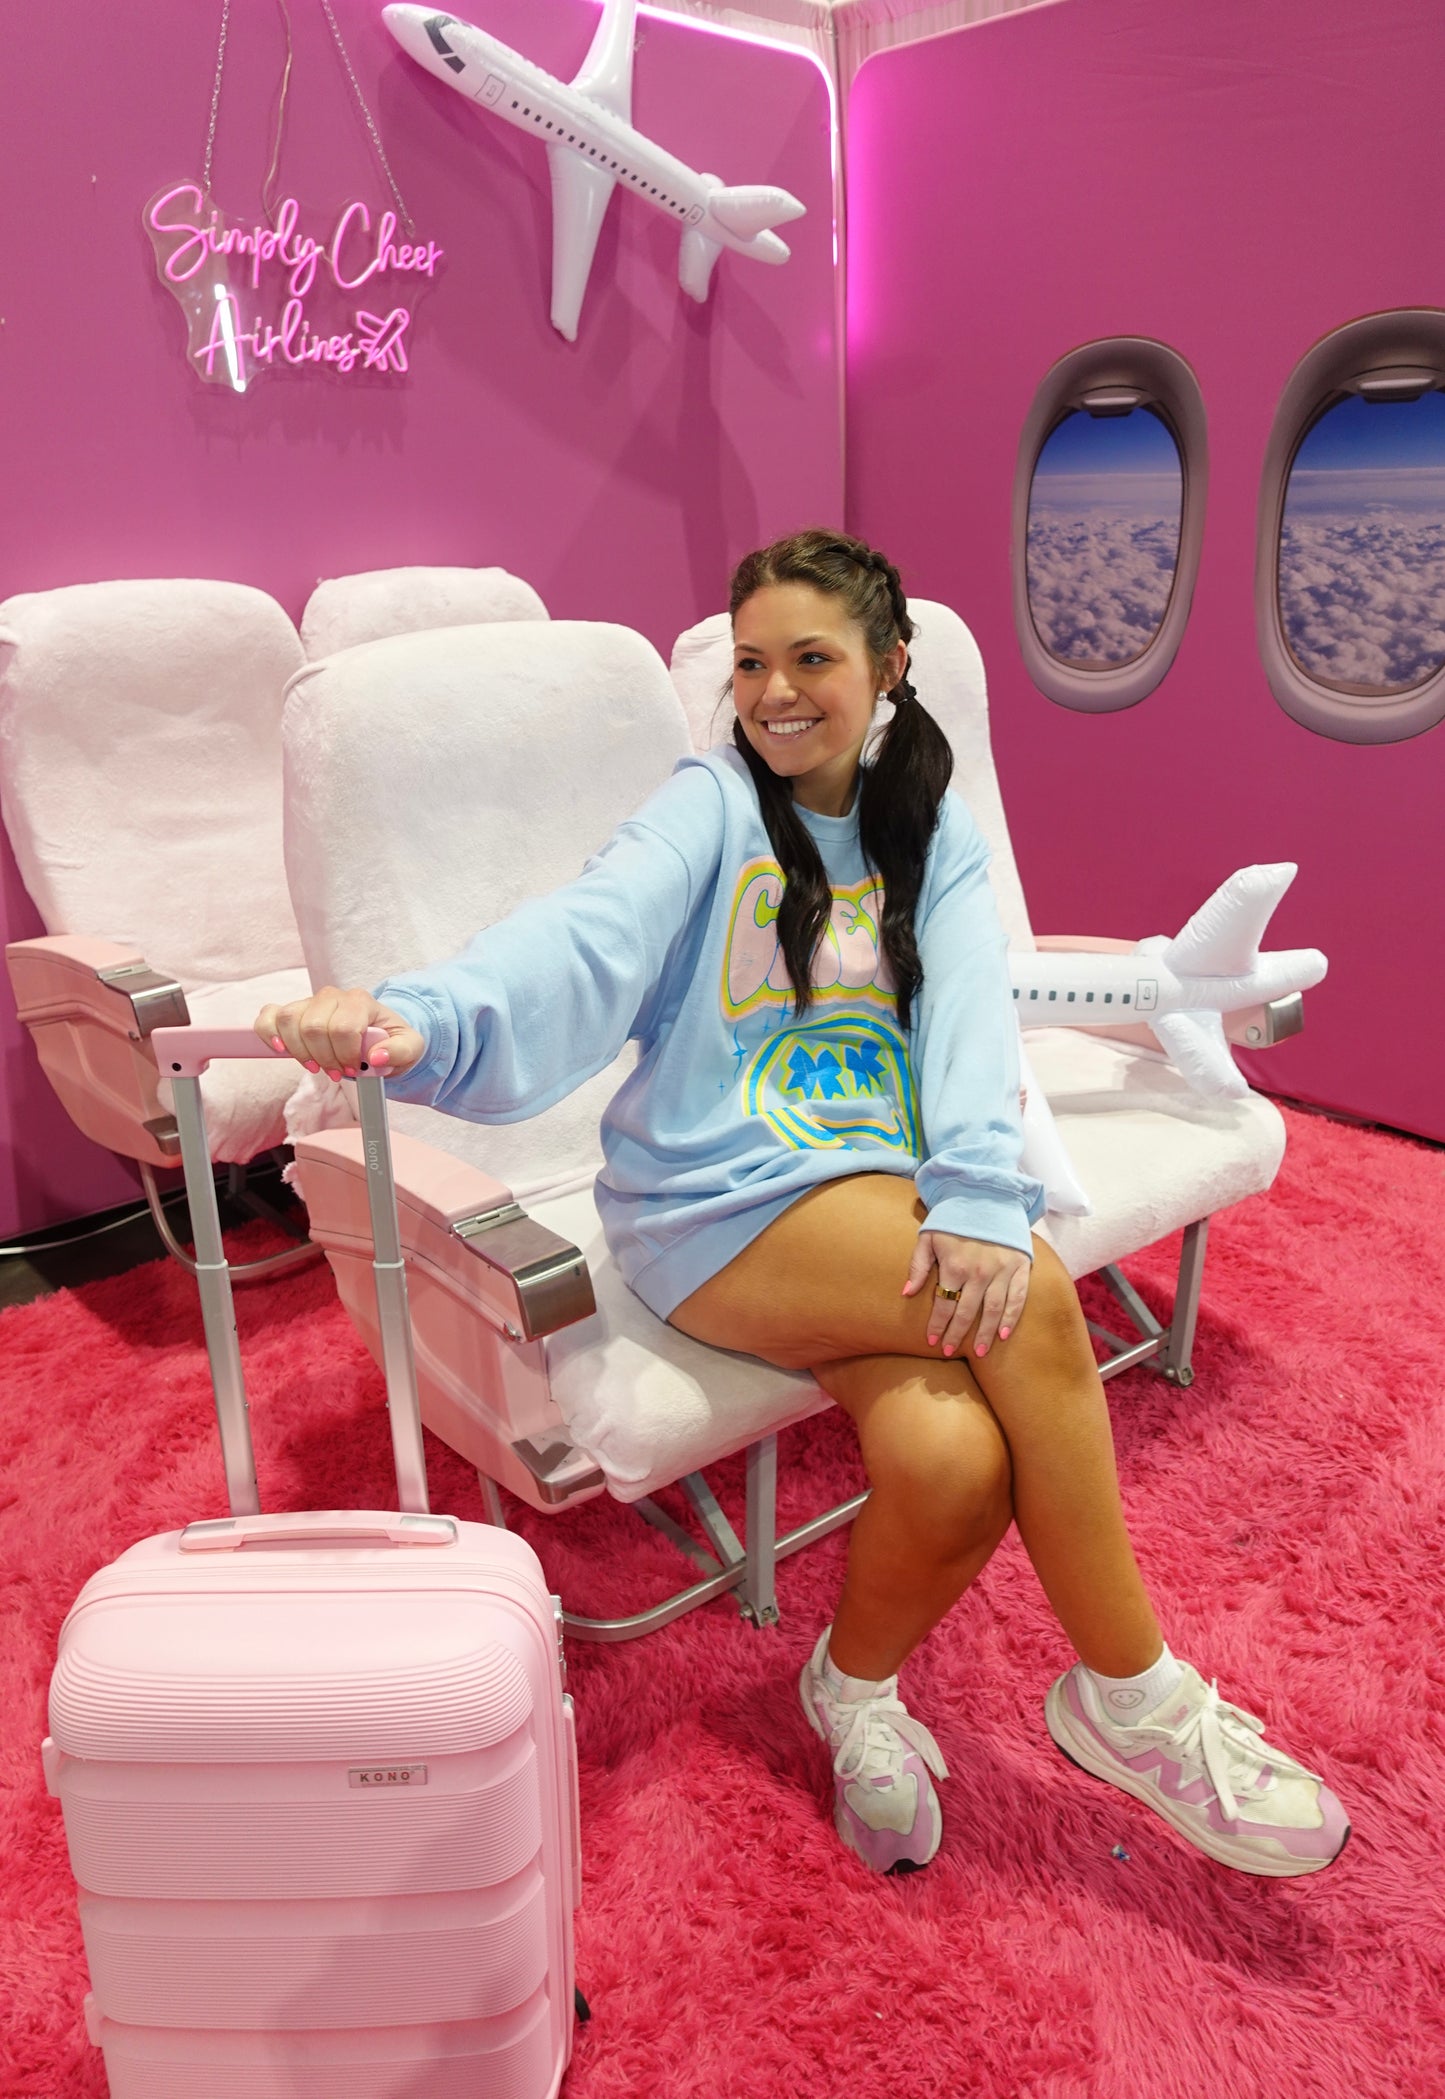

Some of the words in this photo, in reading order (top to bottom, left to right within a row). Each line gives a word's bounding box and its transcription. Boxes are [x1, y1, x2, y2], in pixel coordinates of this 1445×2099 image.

[150, 184, 324, 297] Simply
[332, 202, 444, 289] Cheer
[194, 294, 355, 382] Airlines
[359, 1770, 410, 1783] KONO
